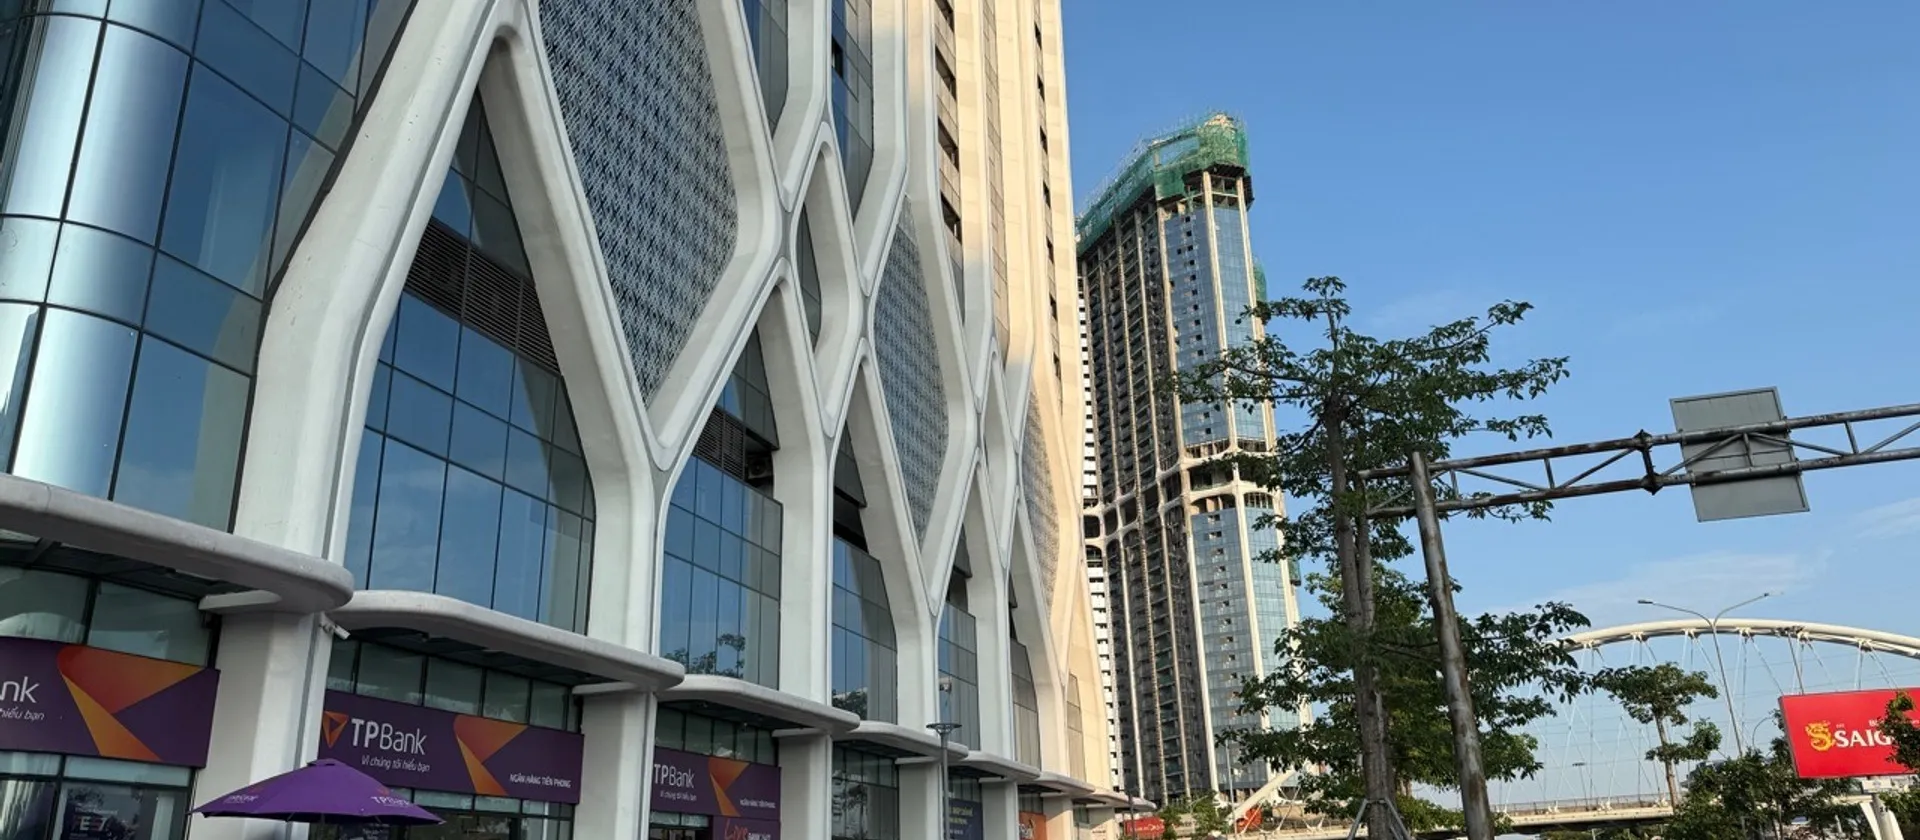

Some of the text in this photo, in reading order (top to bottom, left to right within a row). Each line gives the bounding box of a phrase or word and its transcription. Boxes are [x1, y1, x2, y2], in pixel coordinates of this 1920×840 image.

[0, 676, 40, 703] nk
[351, 718, 428, 756] TPBank
[1834, 729, 1895, 748] SAIG
[370, 755, 391, 771] chúng
[654, 763, 696, 789] TPBank
